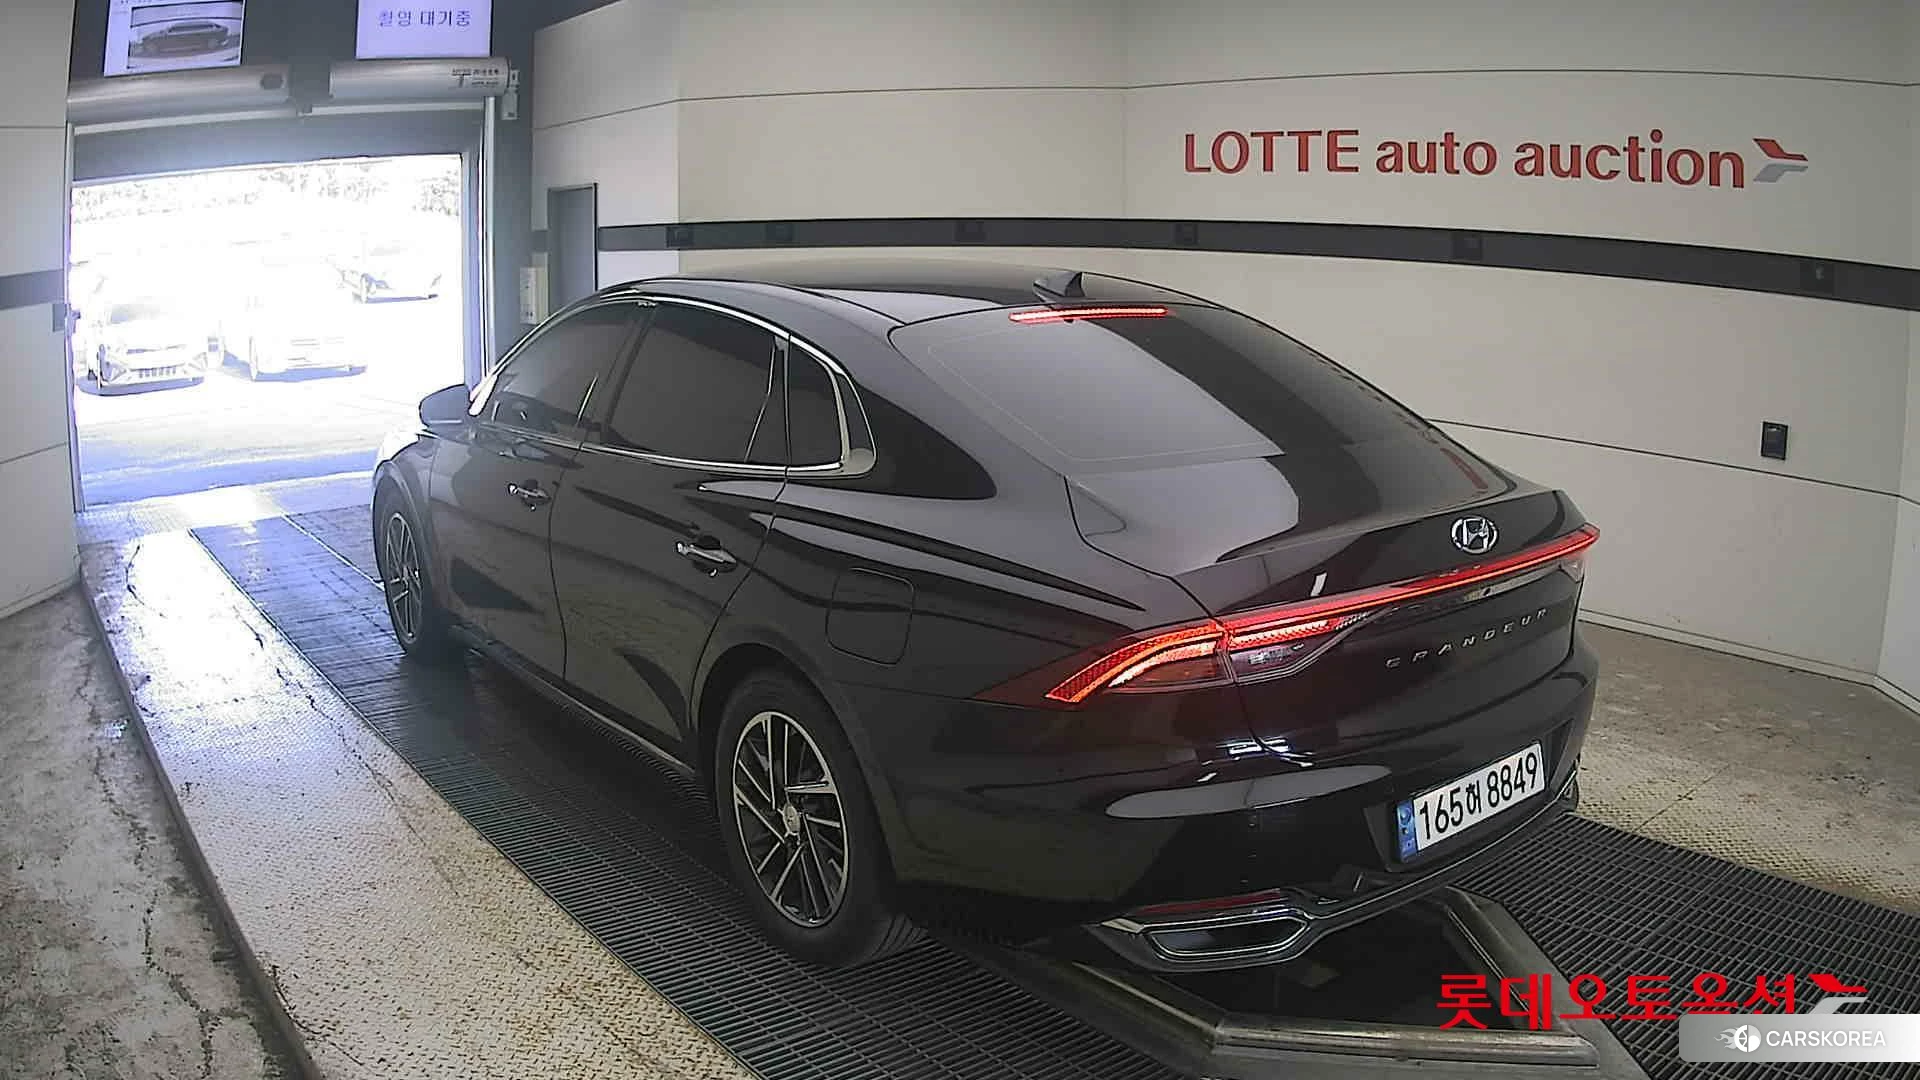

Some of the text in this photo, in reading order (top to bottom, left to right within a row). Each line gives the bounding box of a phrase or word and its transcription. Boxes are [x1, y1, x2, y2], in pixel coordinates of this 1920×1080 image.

[420, 10, 472, 27] 대기중
[1185, 129, 1744, 188] LOTTE auto auction
[1385, 607, 1548, 669] GRANDEUR
[1418, 752, 1538, 840] 165허 8849
